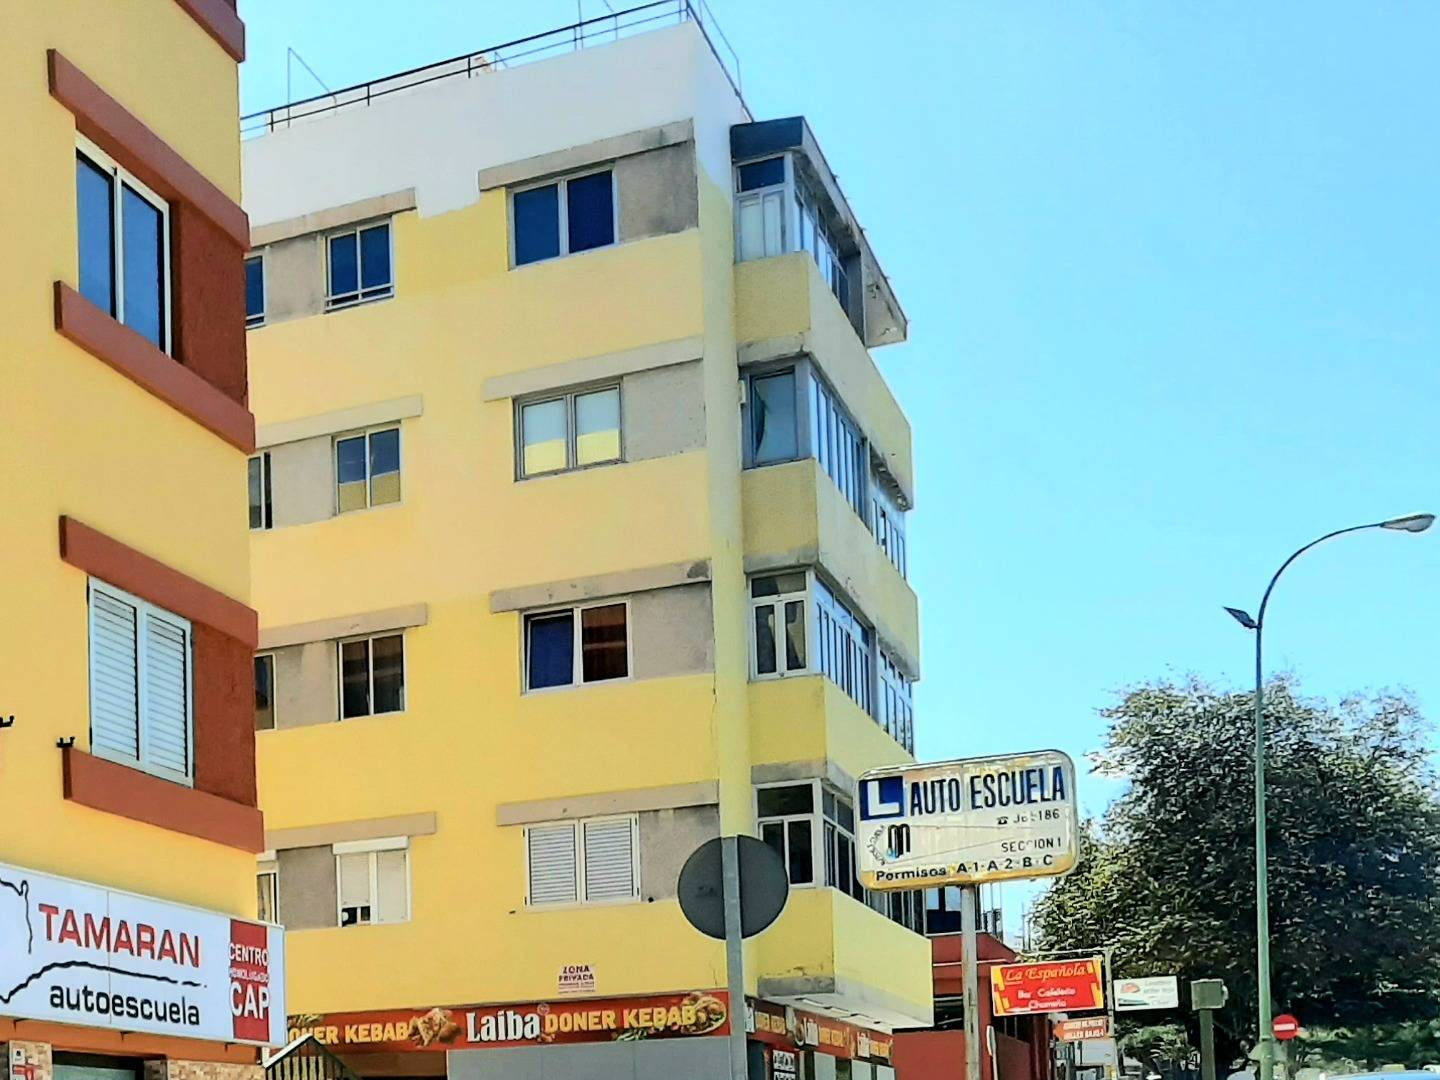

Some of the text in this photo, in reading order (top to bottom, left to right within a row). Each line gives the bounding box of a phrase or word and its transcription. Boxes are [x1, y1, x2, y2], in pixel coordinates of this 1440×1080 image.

[910, 766, 1065, 816] AUTO ESCUELA
[876, 867, 947, 881] Permisos
[38, 903, 200, 968] TAMARAN
[229, 943, 269, 967] CENTRO
[562, 965, 590, 974] ZONA
[1006, 962, 1085, 982] La Española
[49, 985, 200, 1026] autoescuela
[229, 981, 270, 1020] CAP
[288, 1022, 408, 1044] OER KEBAB
[465, 1005, 698, 1043] Laiba DONER KEBAB
